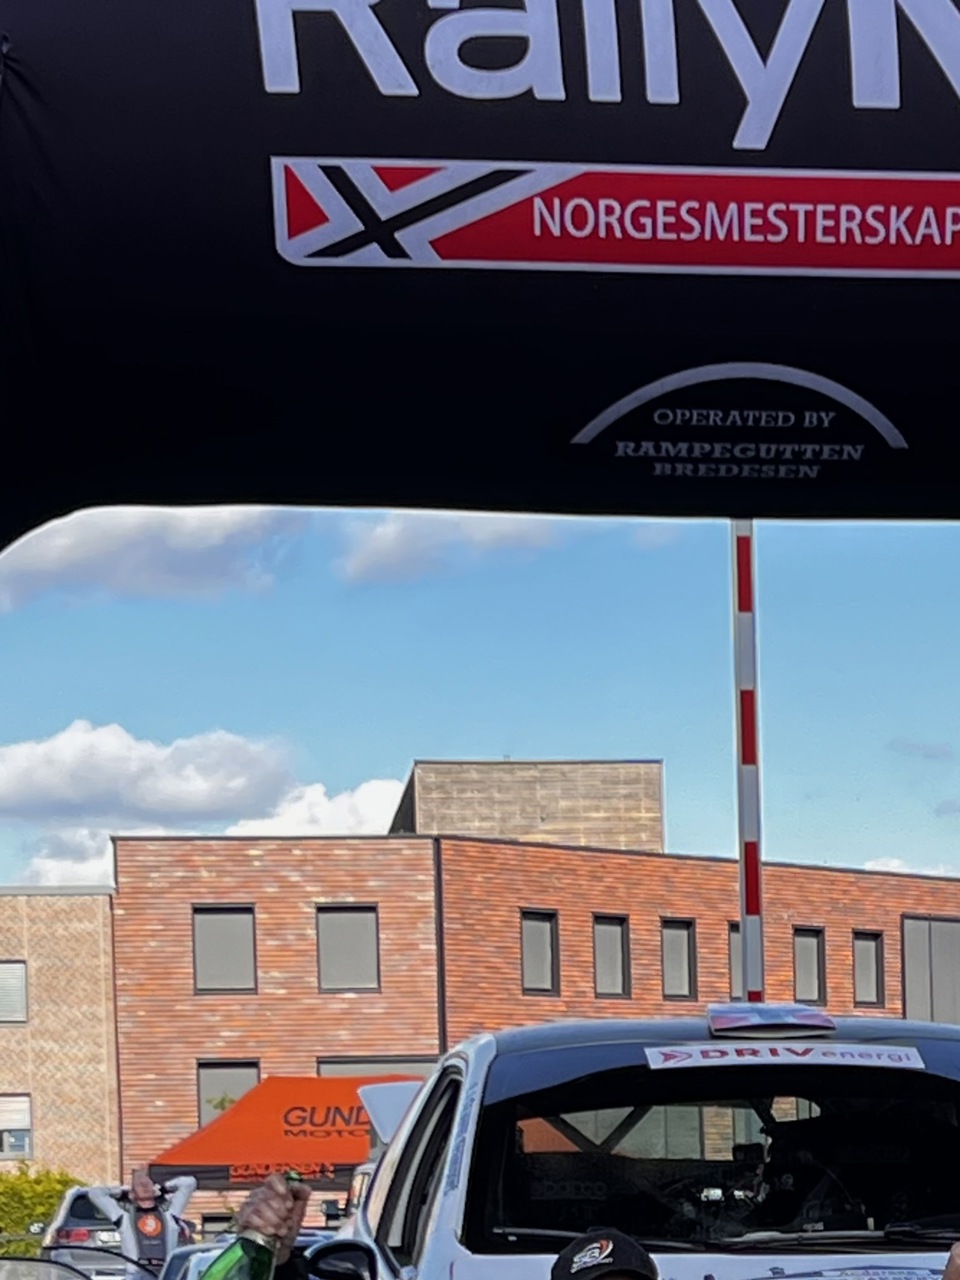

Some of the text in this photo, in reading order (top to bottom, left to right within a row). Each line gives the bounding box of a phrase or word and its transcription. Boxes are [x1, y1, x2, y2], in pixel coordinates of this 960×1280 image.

[652, 408, 837, 428] OPERATED BY
[614, 440, 866, 461] RAMPEGUTTEN
[652, 462, 821, 479] BREDESEN
